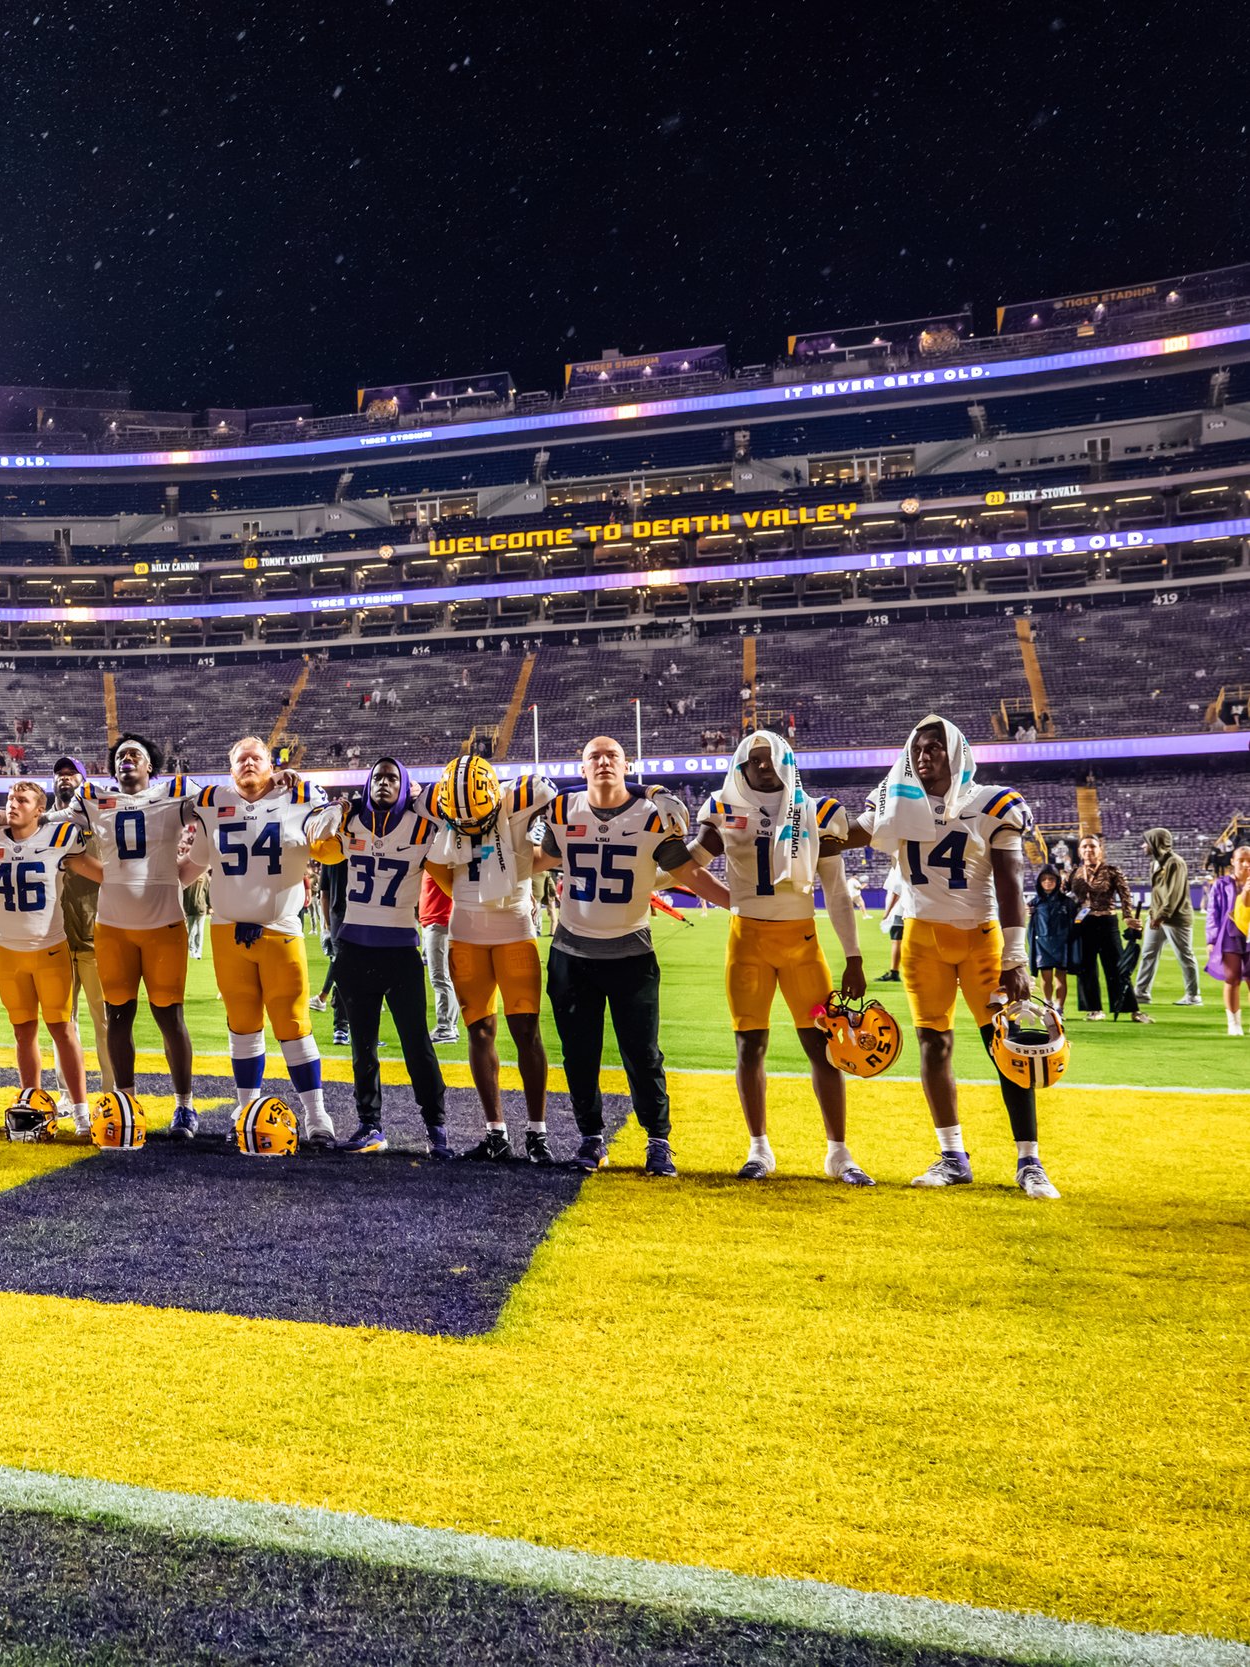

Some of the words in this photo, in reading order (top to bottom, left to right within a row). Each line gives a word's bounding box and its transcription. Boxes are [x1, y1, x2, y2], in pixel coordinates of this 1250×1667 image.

[1064, 296, 1098, 308] TIGER
[1101, 286, 1157, 304] STADIUM
[585, 361, 612, 373] TIGER
[615, 356, 660, 369] STADIUM
[785, 387, 803, 399] IT
[811, 379, 875, 396] NEVER
[883, 372, 935, 388] GETS
[943, 367, 990, 381] OLD.
[359, 436, 387, 445] TIGER
[390, 431, 432, 442] STADIUM
[14, 456, 50, 468] OLD.
[1008, 489, 1037, 502] JERRY
[1041, 485, 1082, 499] STOVALL
[428, 528, 573, 556] WELCOME
[584, 523, 622, 542] TO
[632, 513, 730, 538] DEATH
[742, 502, 857, 529] VALLEY
[870, 553, 894, 567] IT
[907, 545, 993, 565] NEVER
[1005, 538, 1076, 557] GETS
[1089, 532, 1154, 550] OLD.
[151, 563, 170, 573] BILLY
[171, 562, 200, 572] CANNON
[260, 557, 286, 567] TOMMY
[289, 554, 324, 565] CASANOVA
[311, 598, 345, 609] TIGER
[349, 594, 404, 605] STADIUM
[1152, 593, 1178, 605] 419
[866, 615, 889, 626] 418
[197, 657, 215, 668] 415
[685, 758, 729, 771] OLD
[115, 811, 147, 860] 0
[791, 808, 801, 859] POWERADE
[218, 822, 283, 876] 54
[754, 837, 775, 896] 1
[906, 831, 969, 890] 14
[348, 855, 410, 907] 37
[567, 843, 638, 904] 55
[1015, 1046, 1055, 1055] TIGERS
